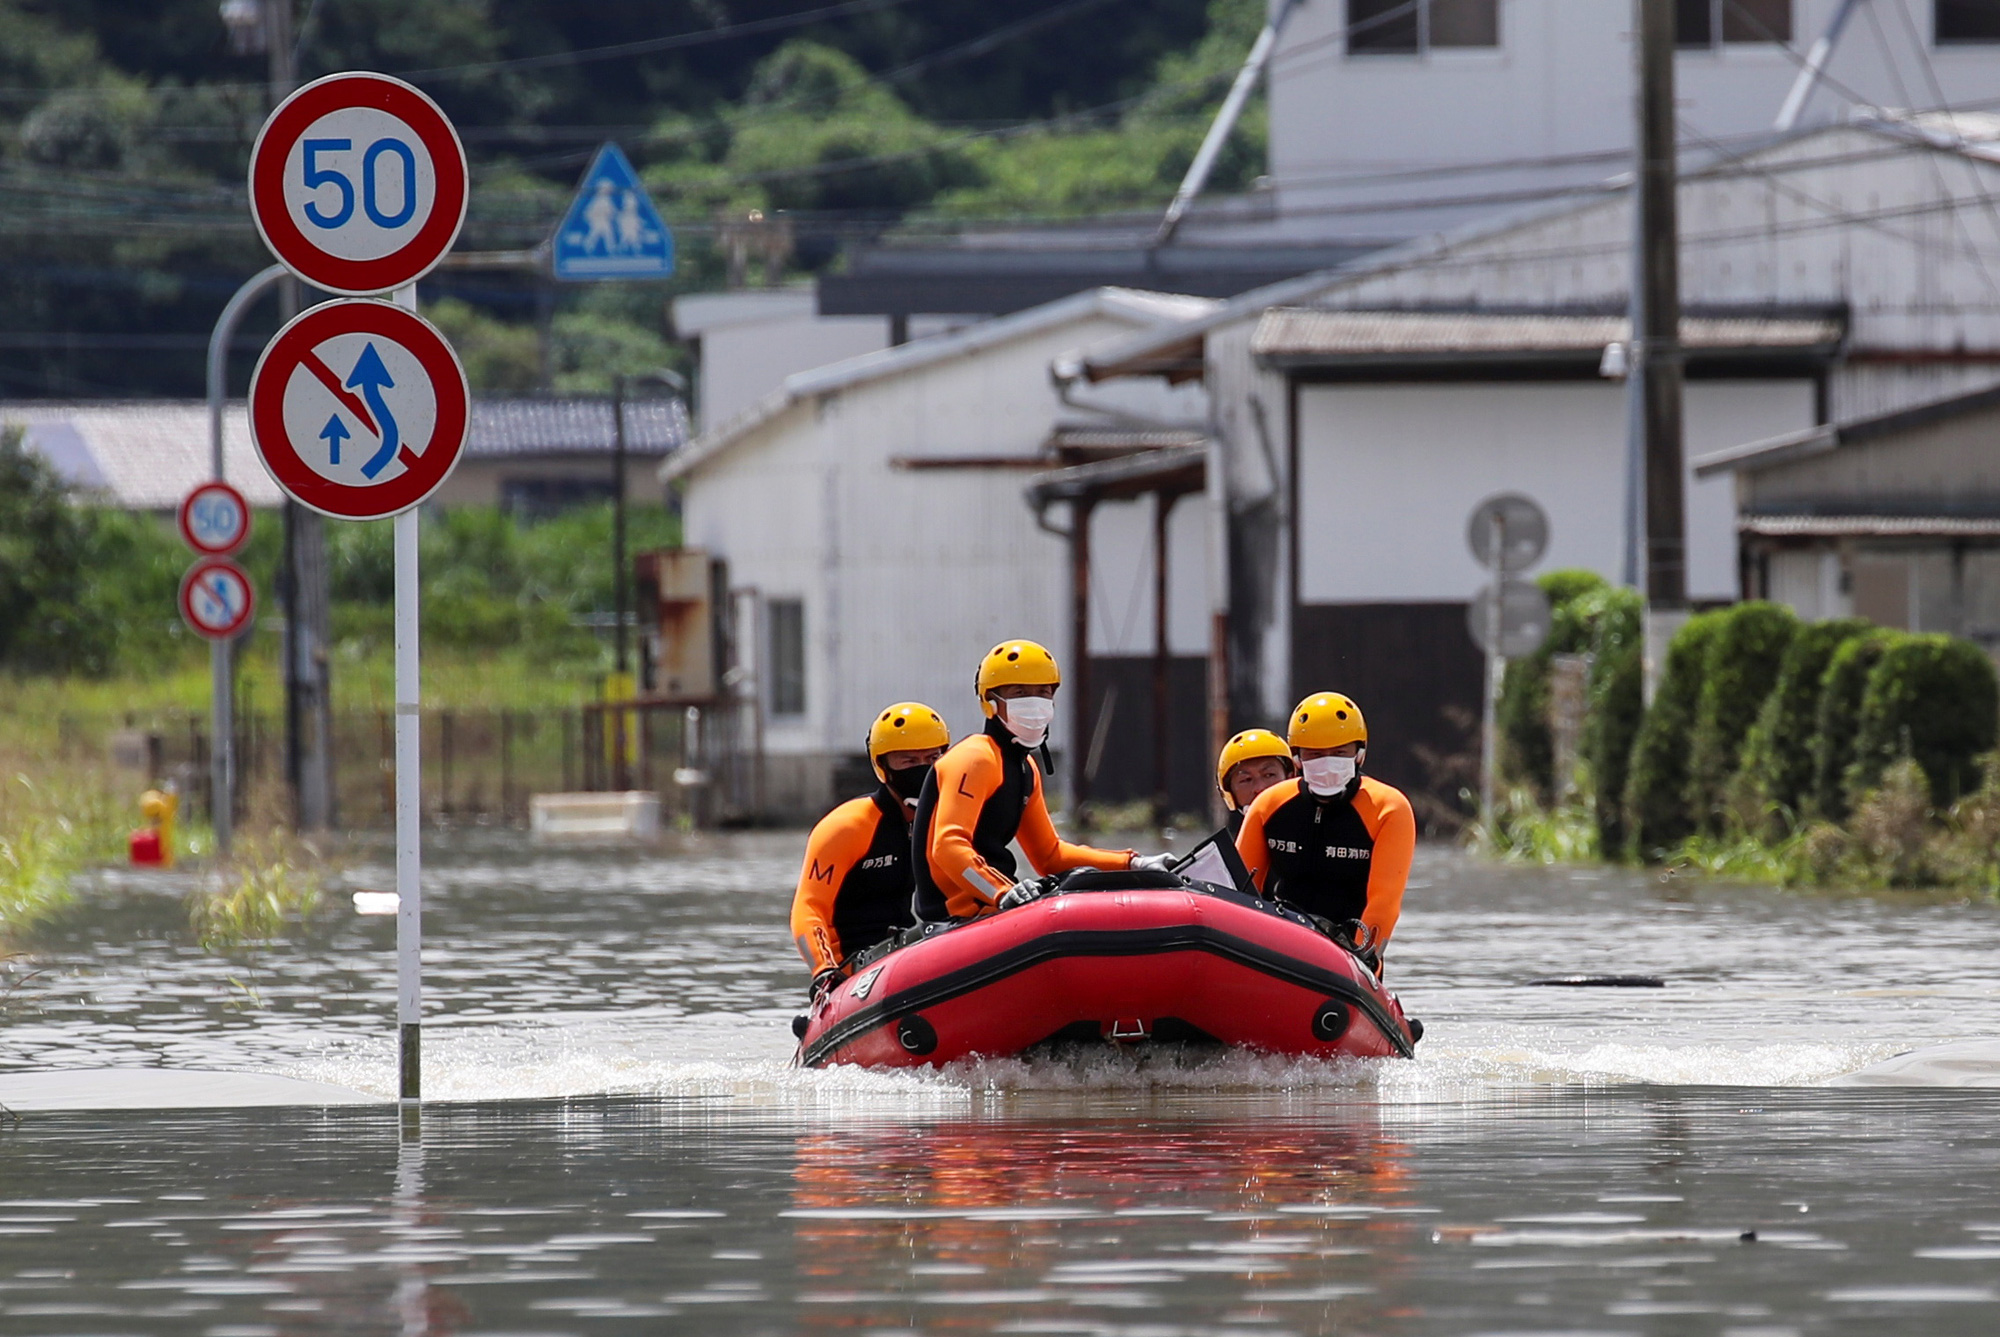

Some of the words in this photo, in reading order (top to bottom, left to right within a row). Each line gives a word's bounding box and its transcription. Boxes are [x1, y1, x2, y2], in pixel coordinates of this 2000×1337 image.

[303, 138, 416, 229] 50
[194, 499, 236, 538] 50
[958, 773, 975, 799] L
[1325, 845, 1371, 860] 有田消防
[808, 858, 835, 886] M
